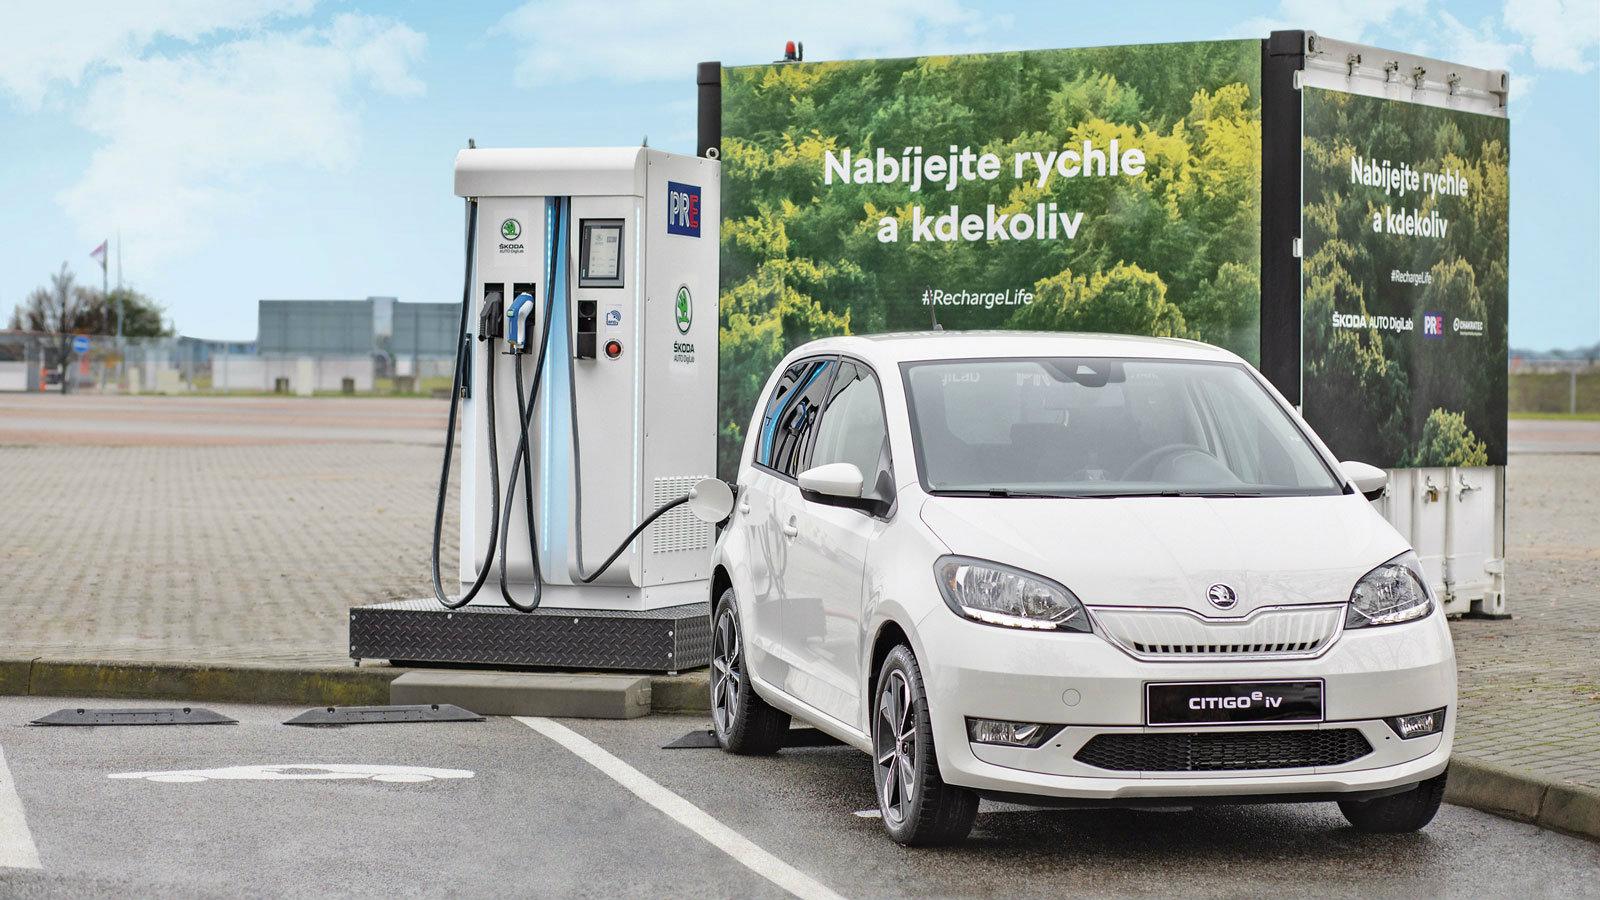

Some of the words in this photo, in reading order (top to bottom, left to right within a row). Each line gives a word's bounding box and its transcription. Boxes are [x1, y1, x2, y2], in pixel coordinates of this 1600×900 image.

[824, 144, 1001, 192] Nabíjejte
[1014, 139, 1147, 188] rychle
[1350, 155, 1420, 197] Nabíjejte
[1423, 168, 1469, 200] rychle
[669, 190, 699, 228] PRE
[877, 215, 898, 243] a
[912, 202, 1084, 242] kdekoliv
[1372, 211, 1382, 233] a
[1386, 205, 1448, 238] kdekoliv
[1390, 269, 1432, 286] #RechargeLife
[921, 288, 1033, 309] #RechargeLife
[1332, 311, 1367, 329] ŠKODA
[1368, 315, 1389, 330] AUTO
[1389, 316, 1413, 333] DigiLab
[1424, 315, 1442, 335] PRE
[673, 340, 695, 353] ŠKODA
